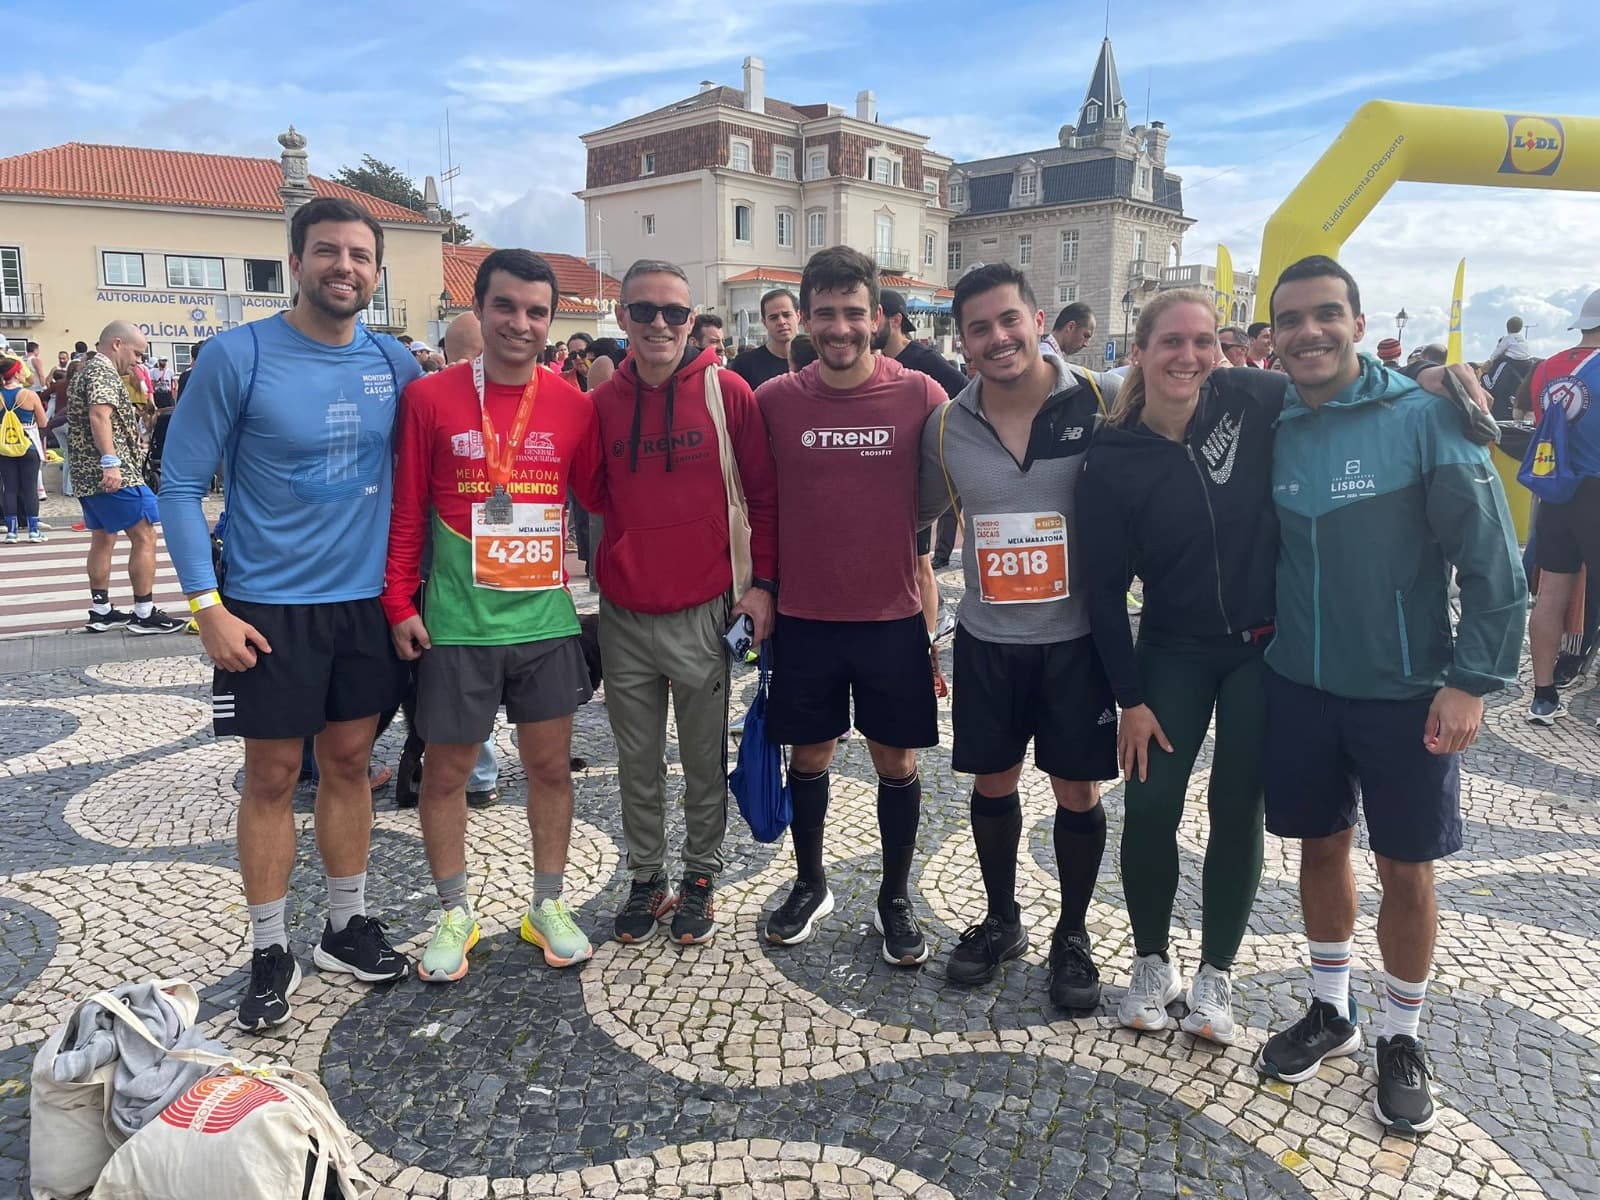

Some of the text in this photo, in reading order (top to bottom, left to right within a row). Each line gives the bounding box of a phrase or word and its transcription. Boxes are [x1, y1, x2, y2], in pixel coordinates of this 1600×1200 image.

[1322, 134, 1405, 232] #LidlAlimentaODesporto
[97, 292, 175, 304] AUTORIDADE
[179, 294, 214, 306] MARÍT
[135, 321, 189, 337] OLÍCIA
[1107, 344, 1113, 359] P
[456, 468, 559, 481] MEIA RATONA
[1331, 480, 1376, 492] LISBOA
[1025, 535, 1064, 544] MARATONA
[487, 540, 554, 564] 4285
[986, 549, 1049, 577] 2818
